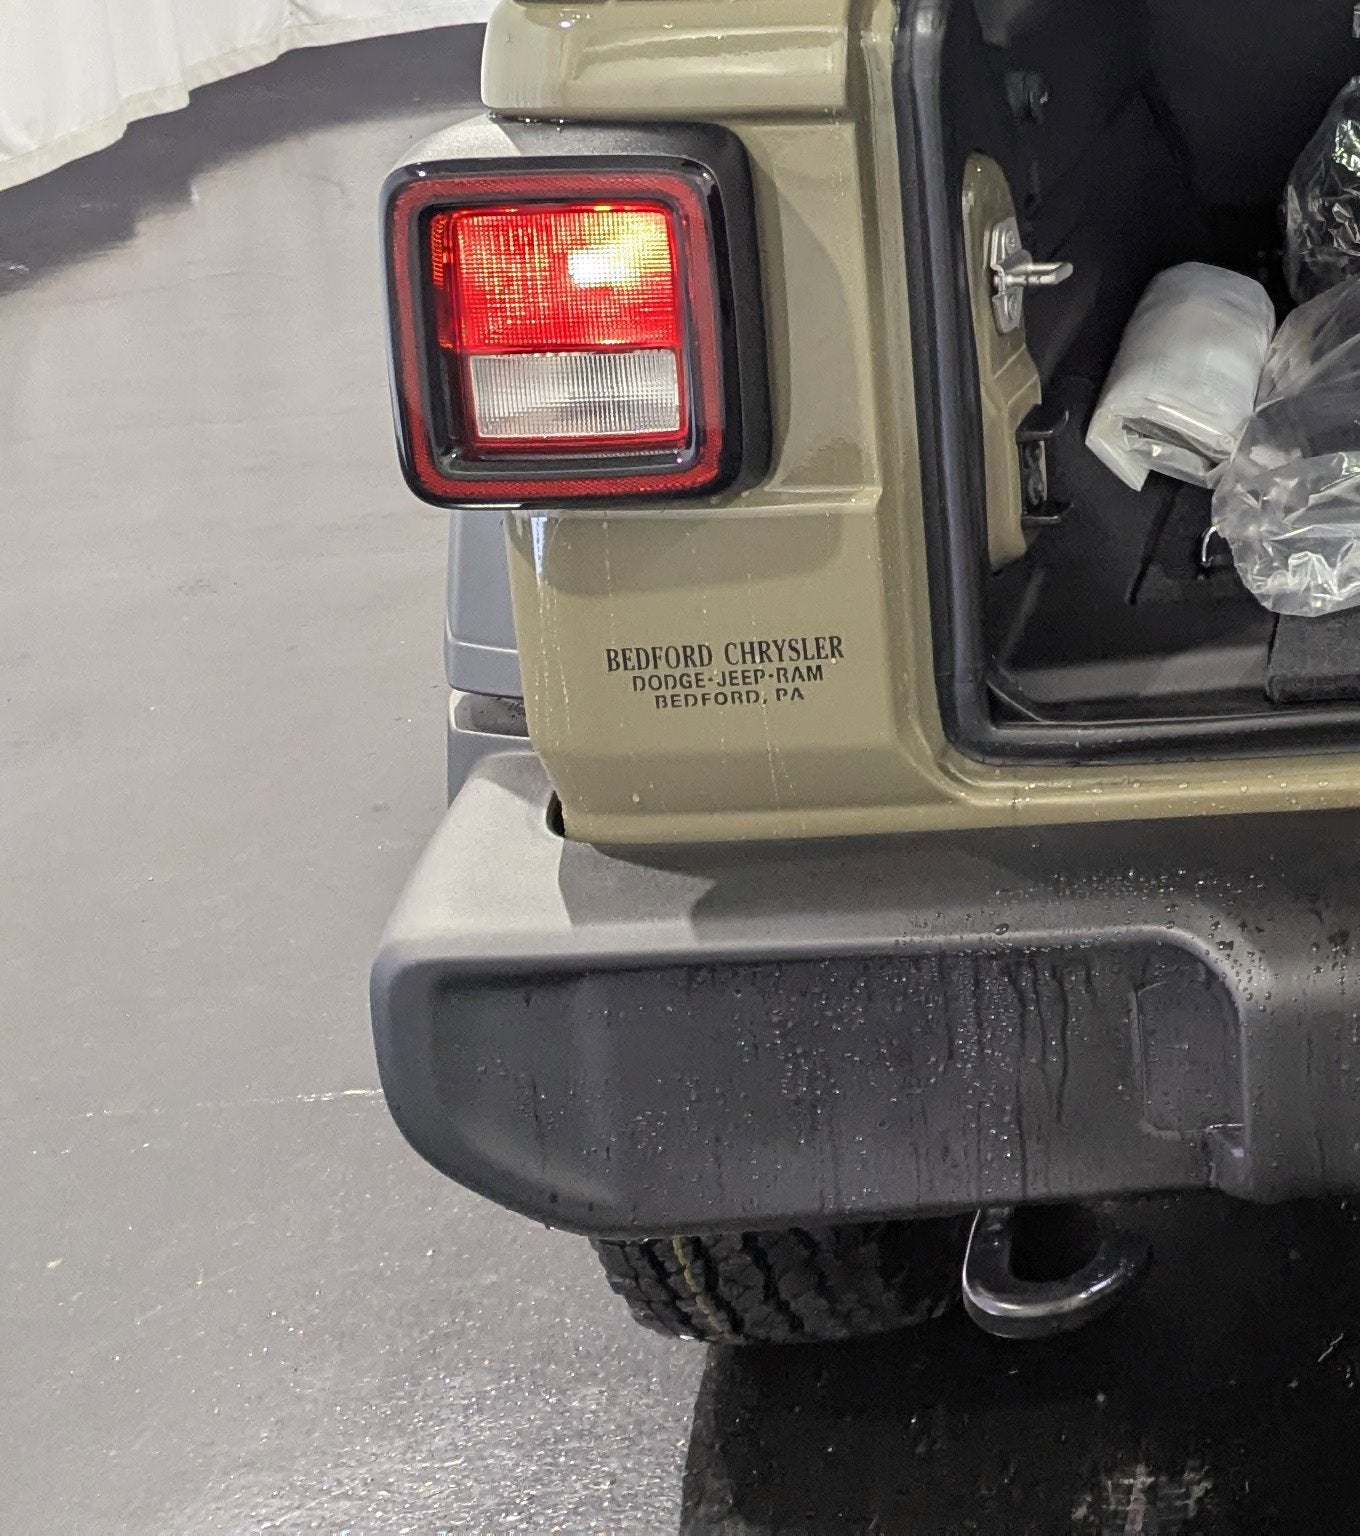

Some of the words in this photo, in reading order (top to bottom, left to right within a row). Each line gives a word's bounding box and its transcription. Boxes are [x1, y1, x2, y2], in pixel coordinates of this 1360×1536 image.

[606, 644, 713, 672] BEDFORD
[724, 635, 844, 666] CHRYSLER
[654, 689, 768, 709] BEDFORD,
[776, 687, 805, 702] PA
